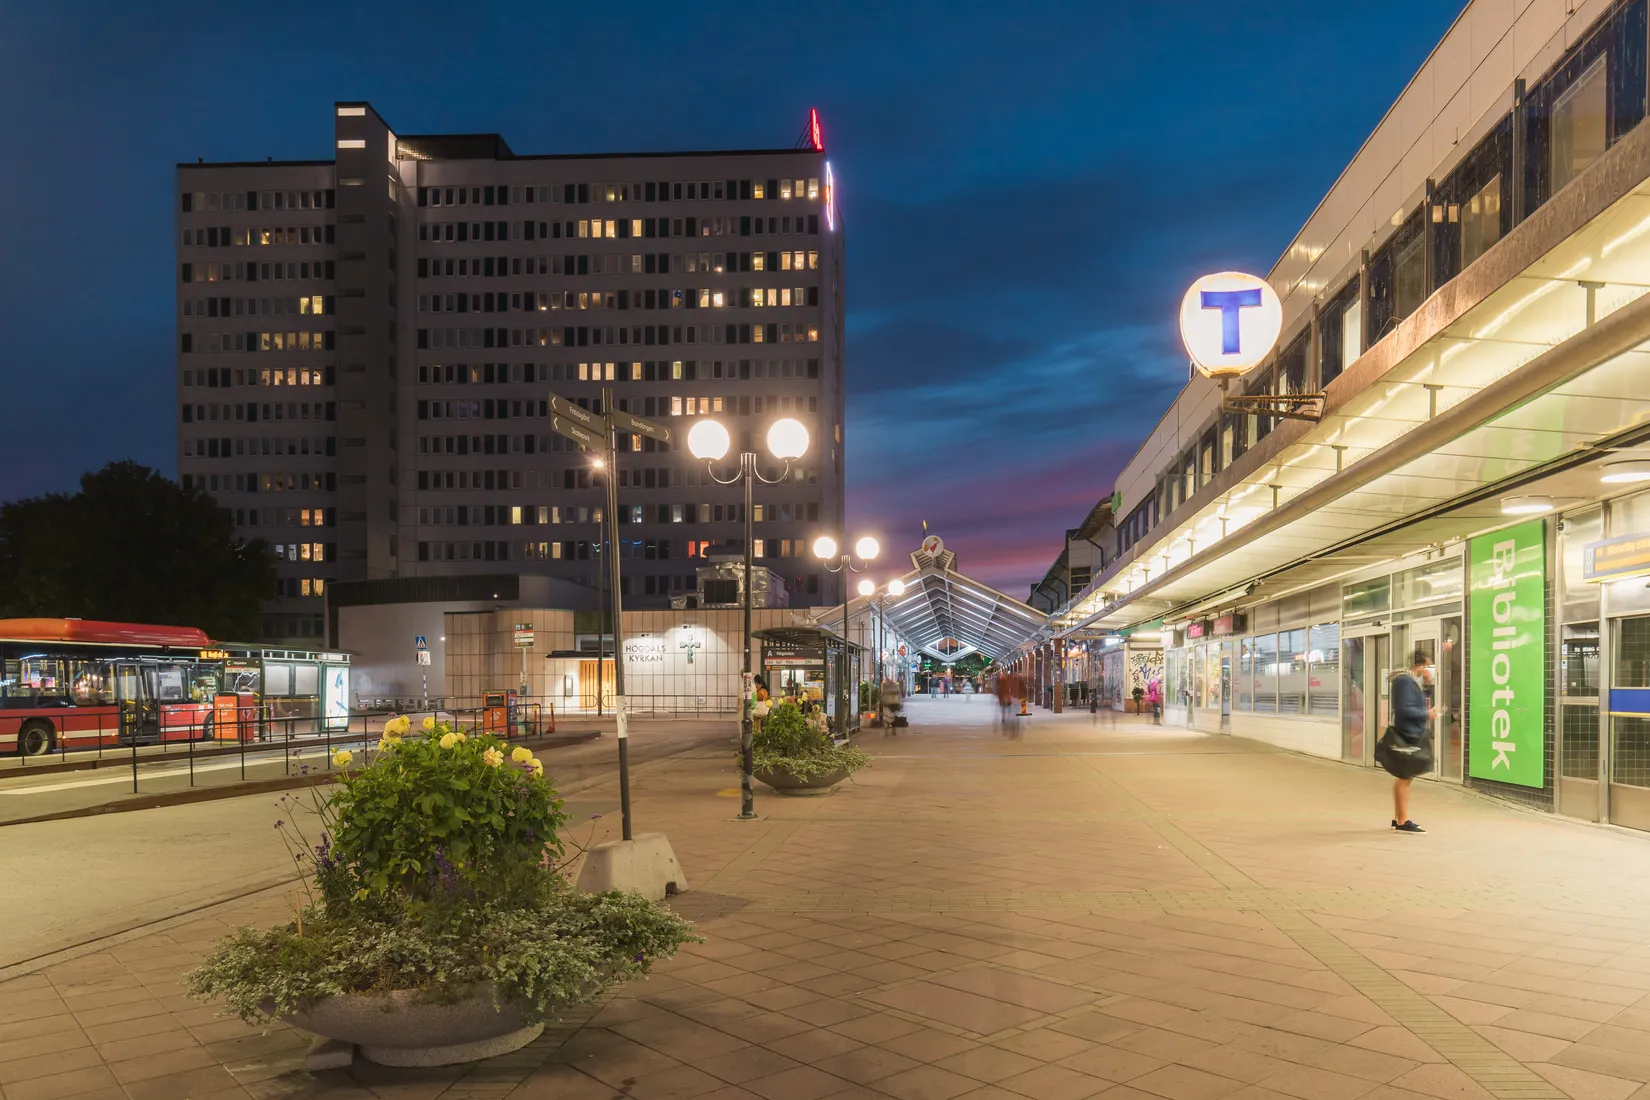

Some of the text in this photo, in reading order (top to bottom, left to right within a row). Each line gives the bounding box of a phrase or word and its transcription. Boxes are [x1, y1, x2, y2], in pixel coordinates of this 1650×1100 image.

[1200, 288, 1262, 355] T
[625, 644, 667, 653] HÖGDALS
[629, 654, 663, 662] KYRKAN
[1491, 538, 1517, 771] Bibliotek
